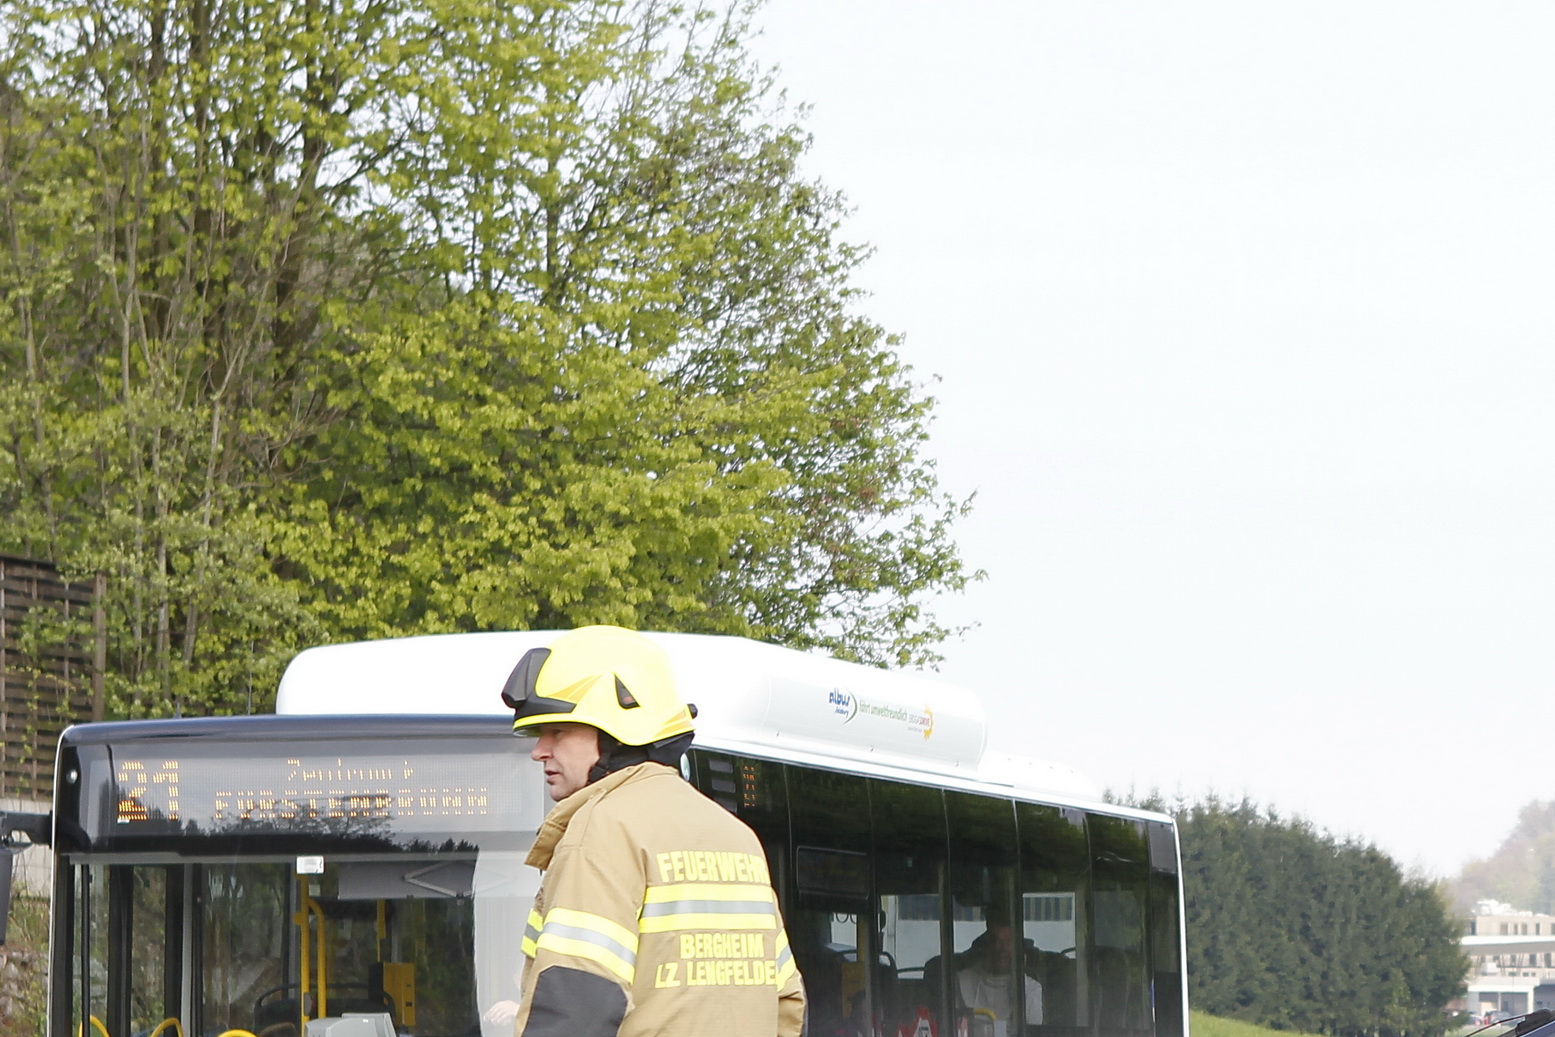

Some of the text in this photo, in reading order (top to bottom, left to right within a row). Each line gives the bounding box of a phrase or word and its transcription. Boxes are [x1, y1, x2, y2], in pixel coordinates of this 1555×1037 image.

[118, 760, 180, 821] 21
[656, 850, 771, 885] FEUERWEHR
[680, 932, 765, 959] BERGHEIM
[654, 960, 777, 989] LZ LENGFELDE
